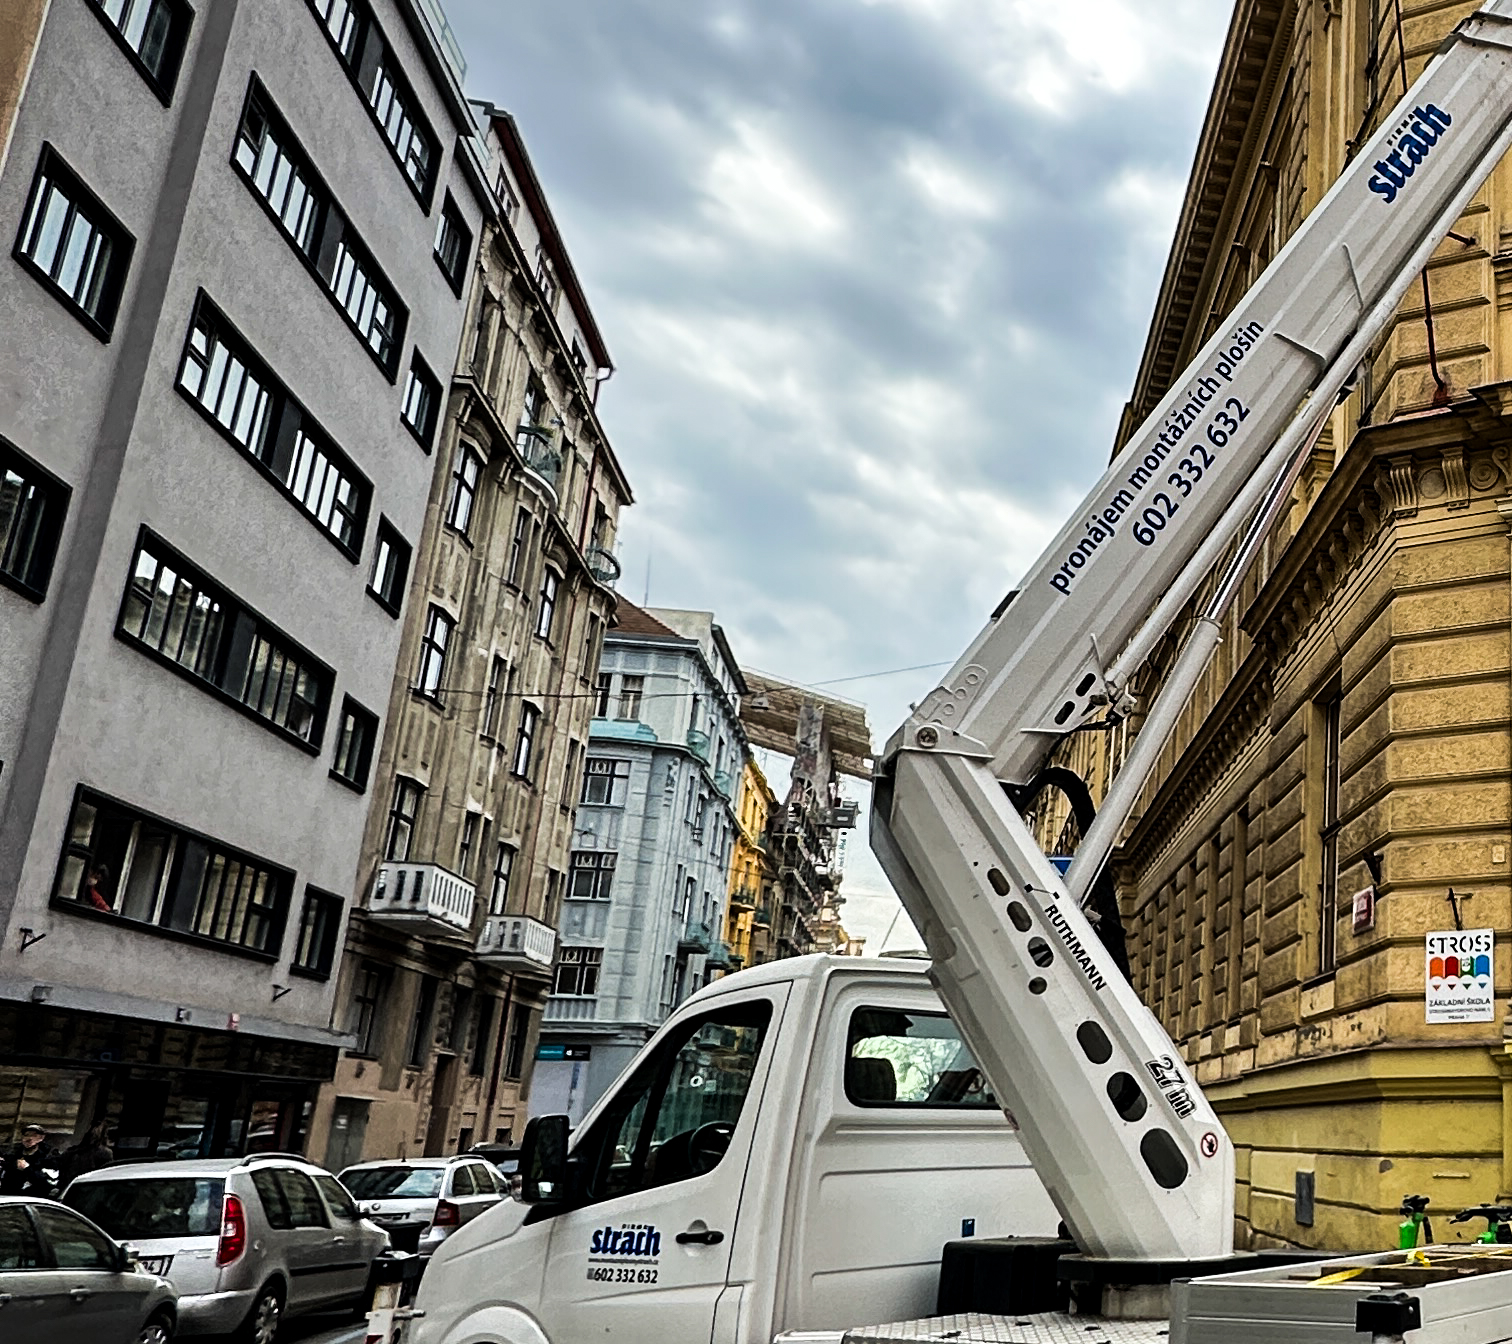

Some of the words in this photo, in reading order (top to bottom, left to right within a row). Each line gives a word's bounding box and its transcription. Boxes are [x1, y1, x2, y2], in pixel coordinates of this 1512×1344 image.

[1368, 103, 1452, 204] strach
[1049, 489, 1135, 596] pronájem
[1128, 377, 1222, 490] montážních
[1215, 321, 1264, 382] plošin
[1133, 493, 1179, 546] 602
[1167, 444, 1215, 498] 332
[1207, 397, 1250, 448] 632
[1044, 904, 1107, 991] RUTHMANN
[590, 1225, 661, 1256] strach
[594, 1268, 614, 1282] 602
[615, 1268, 635, 1283] 332
[637, 1269, 658, 1284] 632
